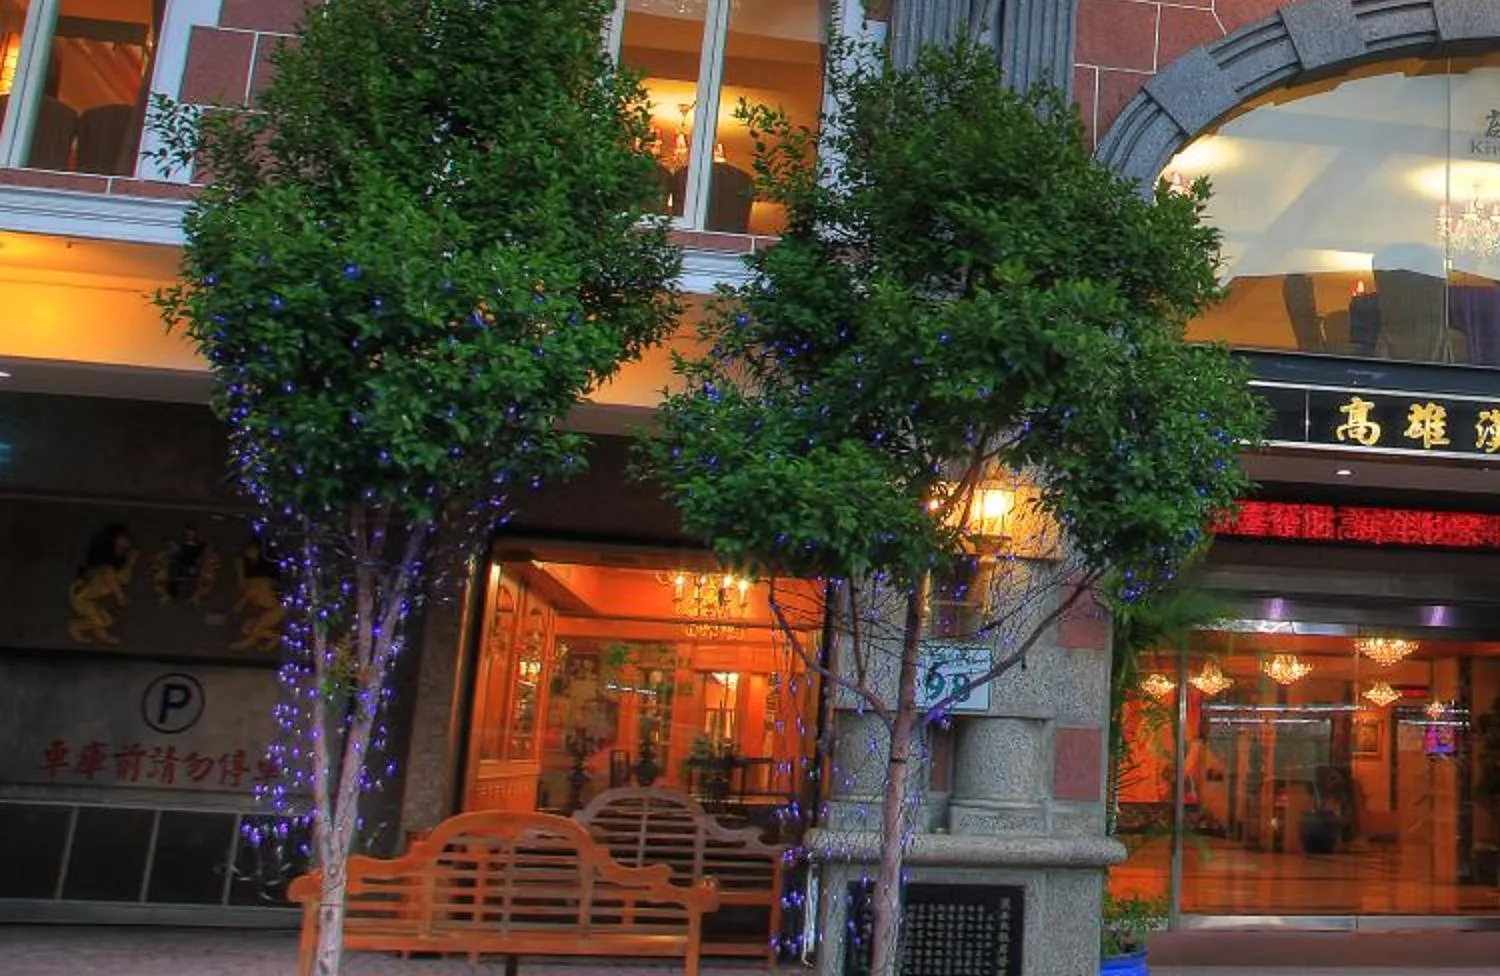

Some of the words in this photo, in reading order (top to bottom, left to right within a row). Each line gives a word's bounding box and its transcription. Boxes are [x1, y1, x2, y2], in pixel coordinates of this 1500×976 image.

[158, 682, 193, 725] P
[39, 738, 282, 787] 車庫前請勿停車
